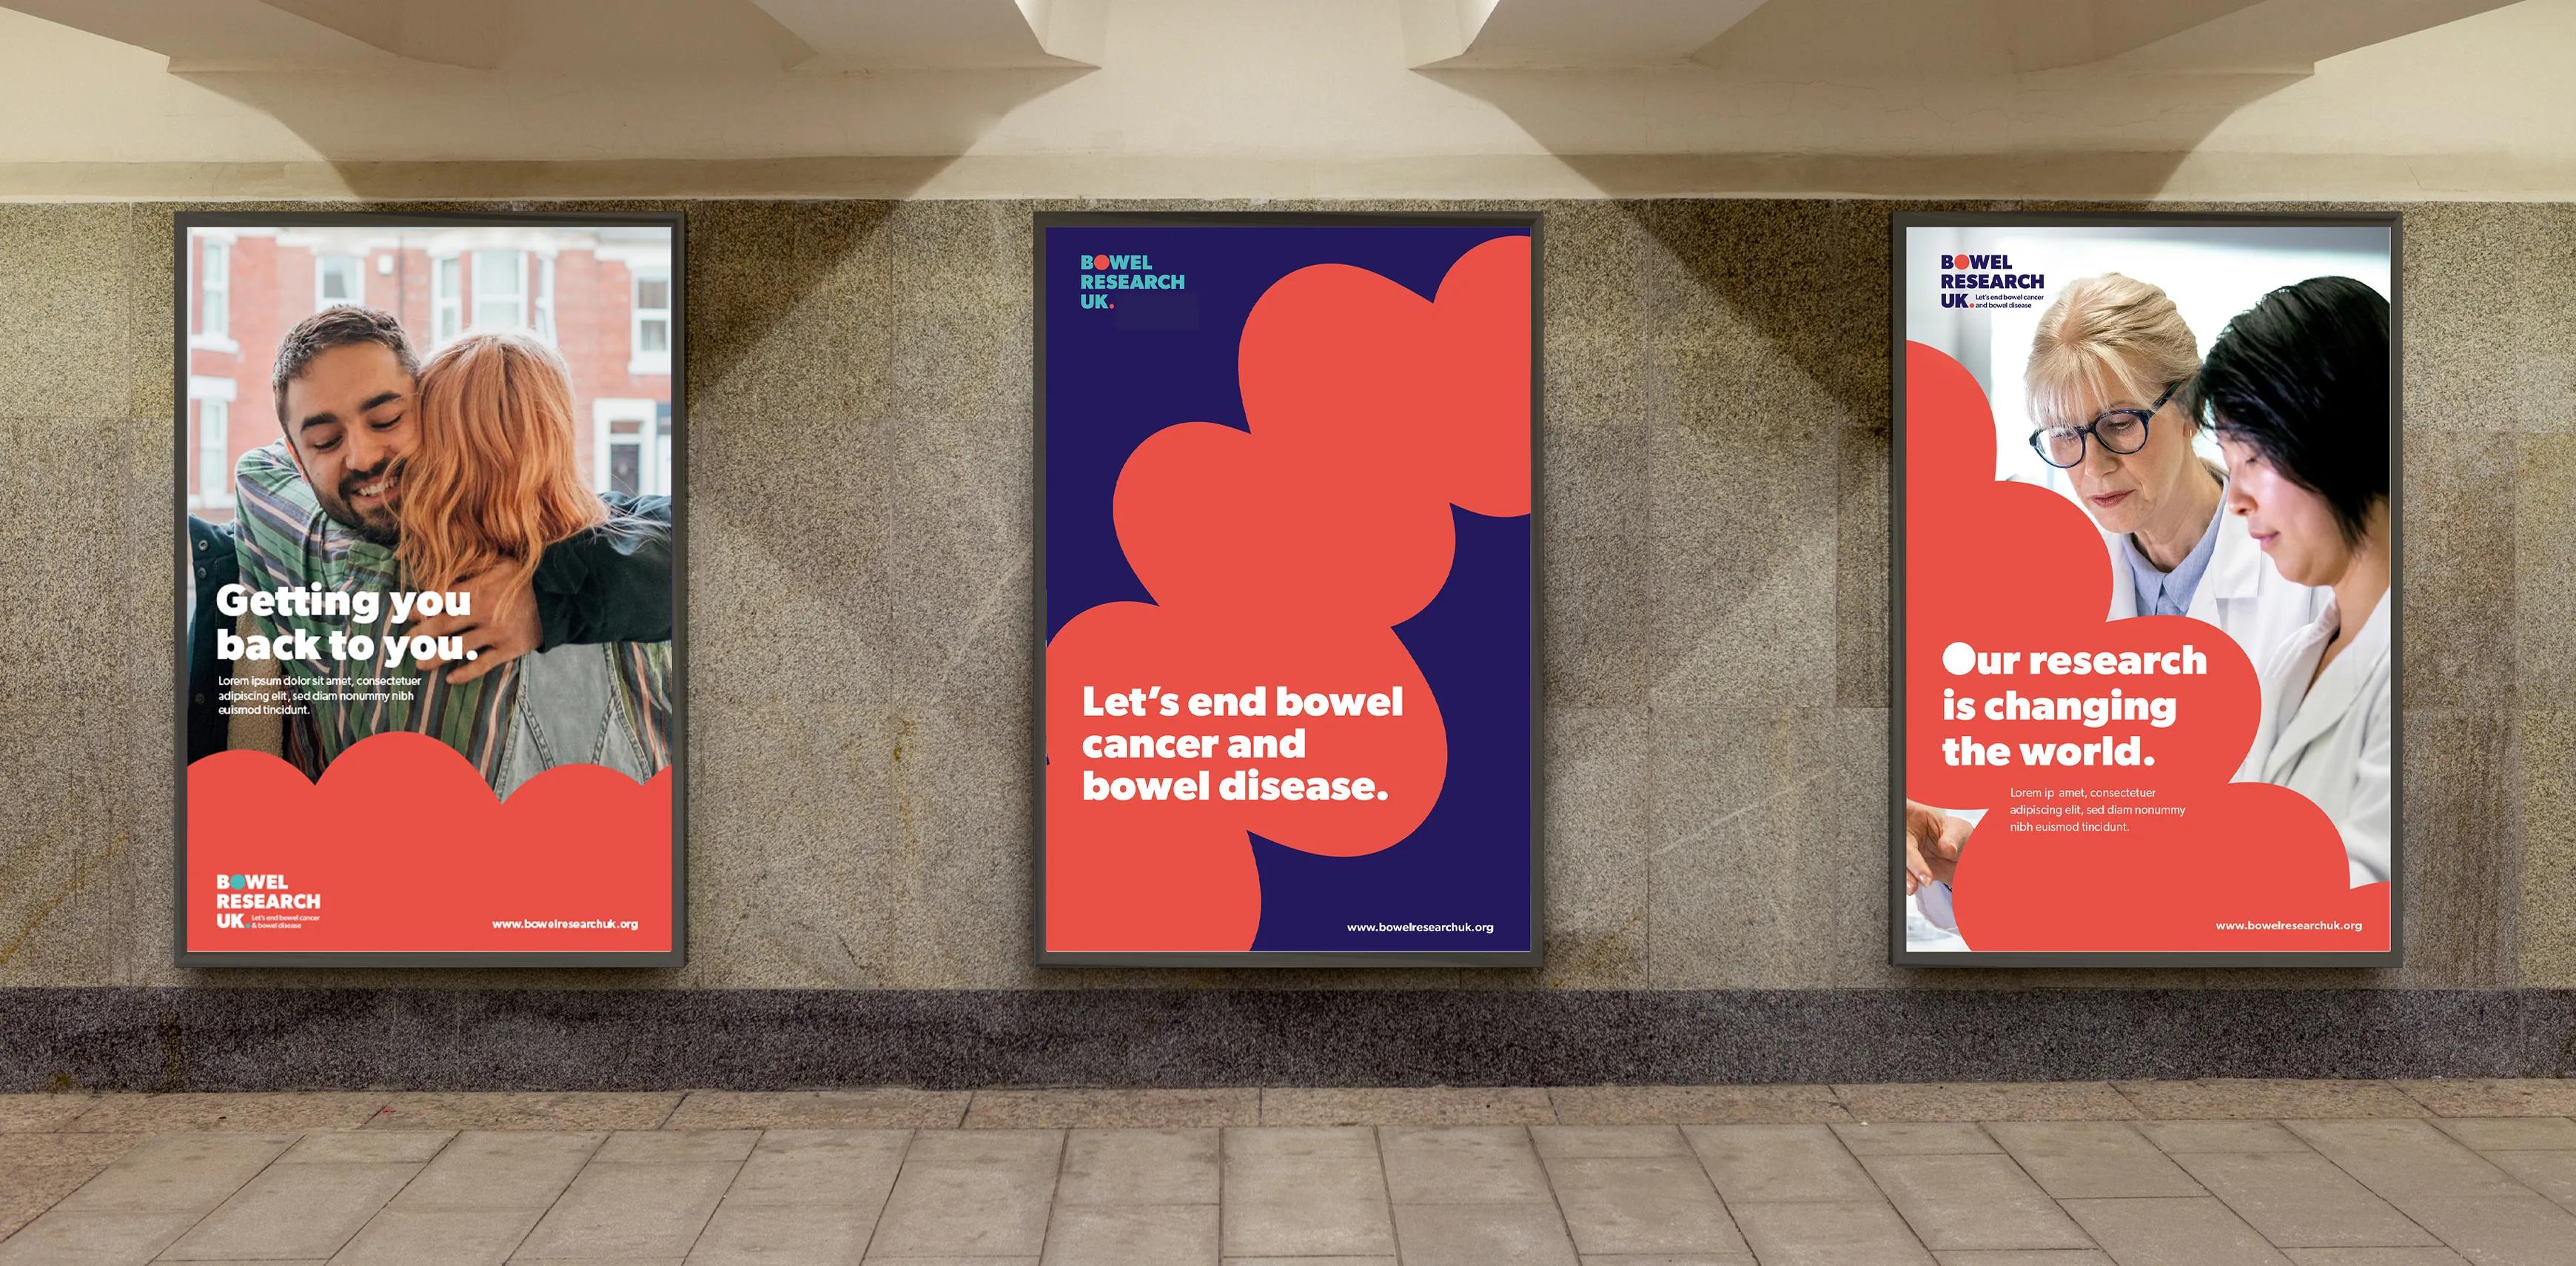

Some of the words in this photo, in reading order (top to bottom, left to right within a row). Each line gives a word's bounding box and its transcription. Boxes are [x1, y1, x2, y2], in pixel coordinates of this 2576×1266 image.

[1081, 255, 1153, 271] BOWEL
[1942, 254, 2013, 270] BOWEL
[1081, 275, 1185, 289] RESEARCH
[1942, 274, 2045, 289] RESEARCH
[1081, 294, 1115, 309] UK.
[1942, 293, 1975, 309] UK.
[217, 582, 380, 624] Getting
[389, 589, 471, 624] you
[217, 629, 321, 661] back
[329, 631, 375, 661] to
[384, 635, 479, 668] you.
[1942, 641, 2020, 675] Our
[2030, 644, 2207, 675] research
[218, 676, 249, 686] Lorem
[252, 676, 281, 688] ipsum
[284, 676, 311, 686] dolor
[312, 676, 324, 686] sit
[326, 677, 355, 688] amet,
[356, 677, 422, 686] consectetuer
[218, 691, 269, 703] adipiscing
[271, 691, 292, 703] elit,
[292, 691, 311, 701] sed
[312, 691, 338, 701] diam
[339, 693, 390, 703] nonummy
[392, 691, 415, 701] nibh
[1084, 686, 1180, 717] Let’s
[1188, 686, 1267, 717] end
[1276, 686, 1403, 717] bowel
[218, 705, 261, 715] euismod
[263, 705, 310, 715] tincidunt.
[1943, 688, 1976, 721] is
[1984, 688, 2176, 729] changing
[1082, 734, 1220, 759] cancer
[1227, 729, 1306, 759] and
[1942, 735, 2011, 766] the
[2019, 735, 2156, 766] world.
[1083, 770, 1210, 801] bowel
[1218, 768, 1389, 801] disease.
[2010, 787, 2042, 798] Lorem
[2045, 787, 2055, 800] ip
[2059, 788, 2087, 799] amet,
[2090, 788, 2156, 798] consectetuer
[2010, 804, 2062, 817] adipiscing
[2065, 804, 2084, 816] elit,
[2087, 804, 2104, 814] sed
[2107, 804, 2133, 815] diam
[2135, 806, 2186, 817] nonummy
[2010, 821, 2033, 831] nibh
[2035, 821, 2079, 832] euismod
[2082, 821, 2130, 832] tincidunt.
[216, 874, 289, 890] BOWEL
[216, 894, 321, 909] RESEARCH
[492, 919, 639, 931] www.bowelresearchuk.org
[1346, 922, 1494, 934] www.bowelresearchuk.org
[2216, 920, 2363, 932] www.bowelresearchuk.org
